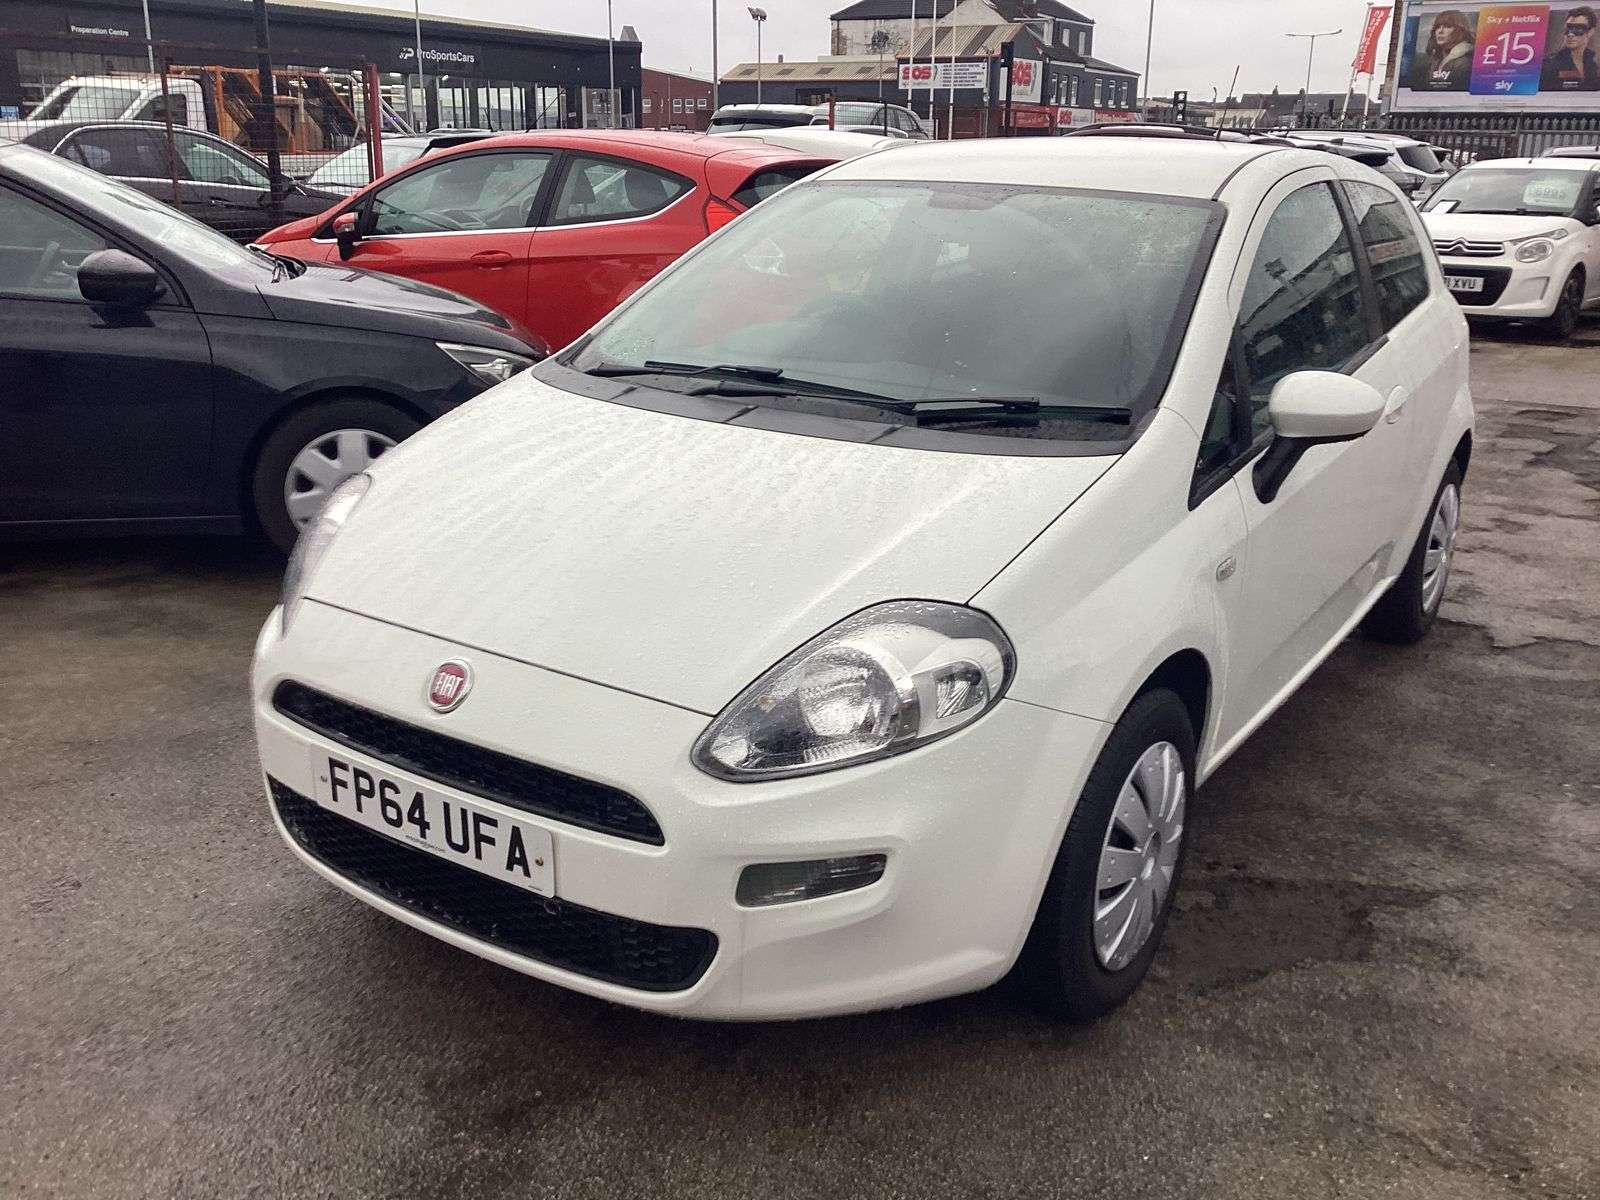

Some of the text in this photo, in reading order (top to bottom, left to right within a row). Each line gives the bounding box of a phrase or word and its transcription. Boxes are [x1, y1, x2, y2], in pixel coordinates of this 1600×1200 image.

[1487, 15, 1503, 25] Sky
[1512, 13, 1541, 23] Netflix
[70, 25, 130, 37] Preparation Centre
[1482, 31, 1536, 65] £15
[1432, 69, 1451, 80] sky
[1495, 80, 1514, 92] sky
[1453, 277, 1477, 290] XVU
[433, 671, 465, 699] FIAT
[327, 756, 532, 879] FP64 UFA
